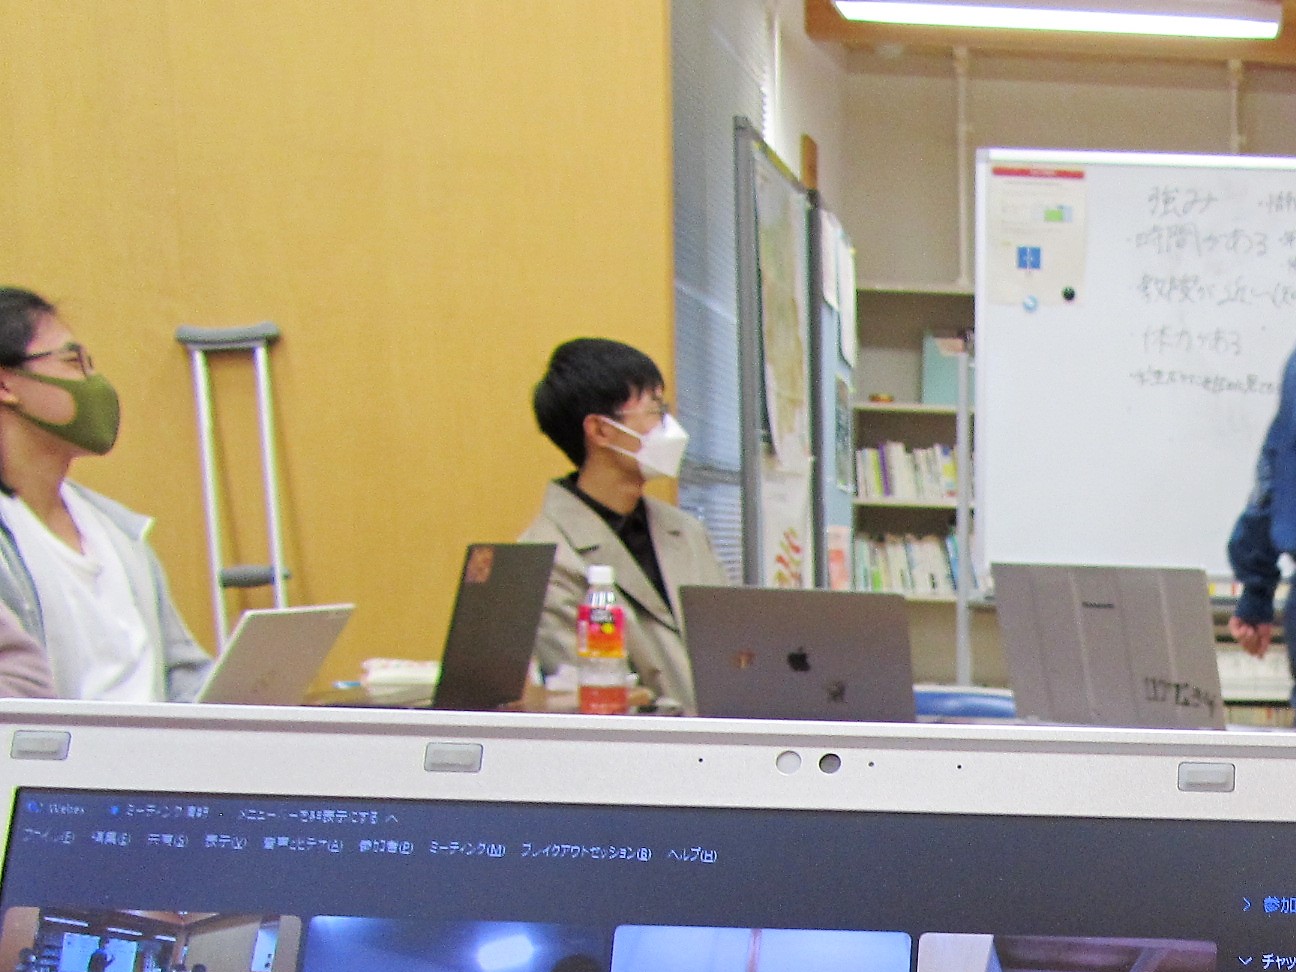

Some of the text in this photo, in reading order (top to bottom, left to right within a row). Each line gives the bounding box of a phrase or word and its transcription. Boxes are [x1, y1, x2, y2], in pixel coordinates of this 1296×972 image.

[429, 840, 506, 858] ミーティング(M)
[667, 846, 718, 864] ヘルプ(H)
